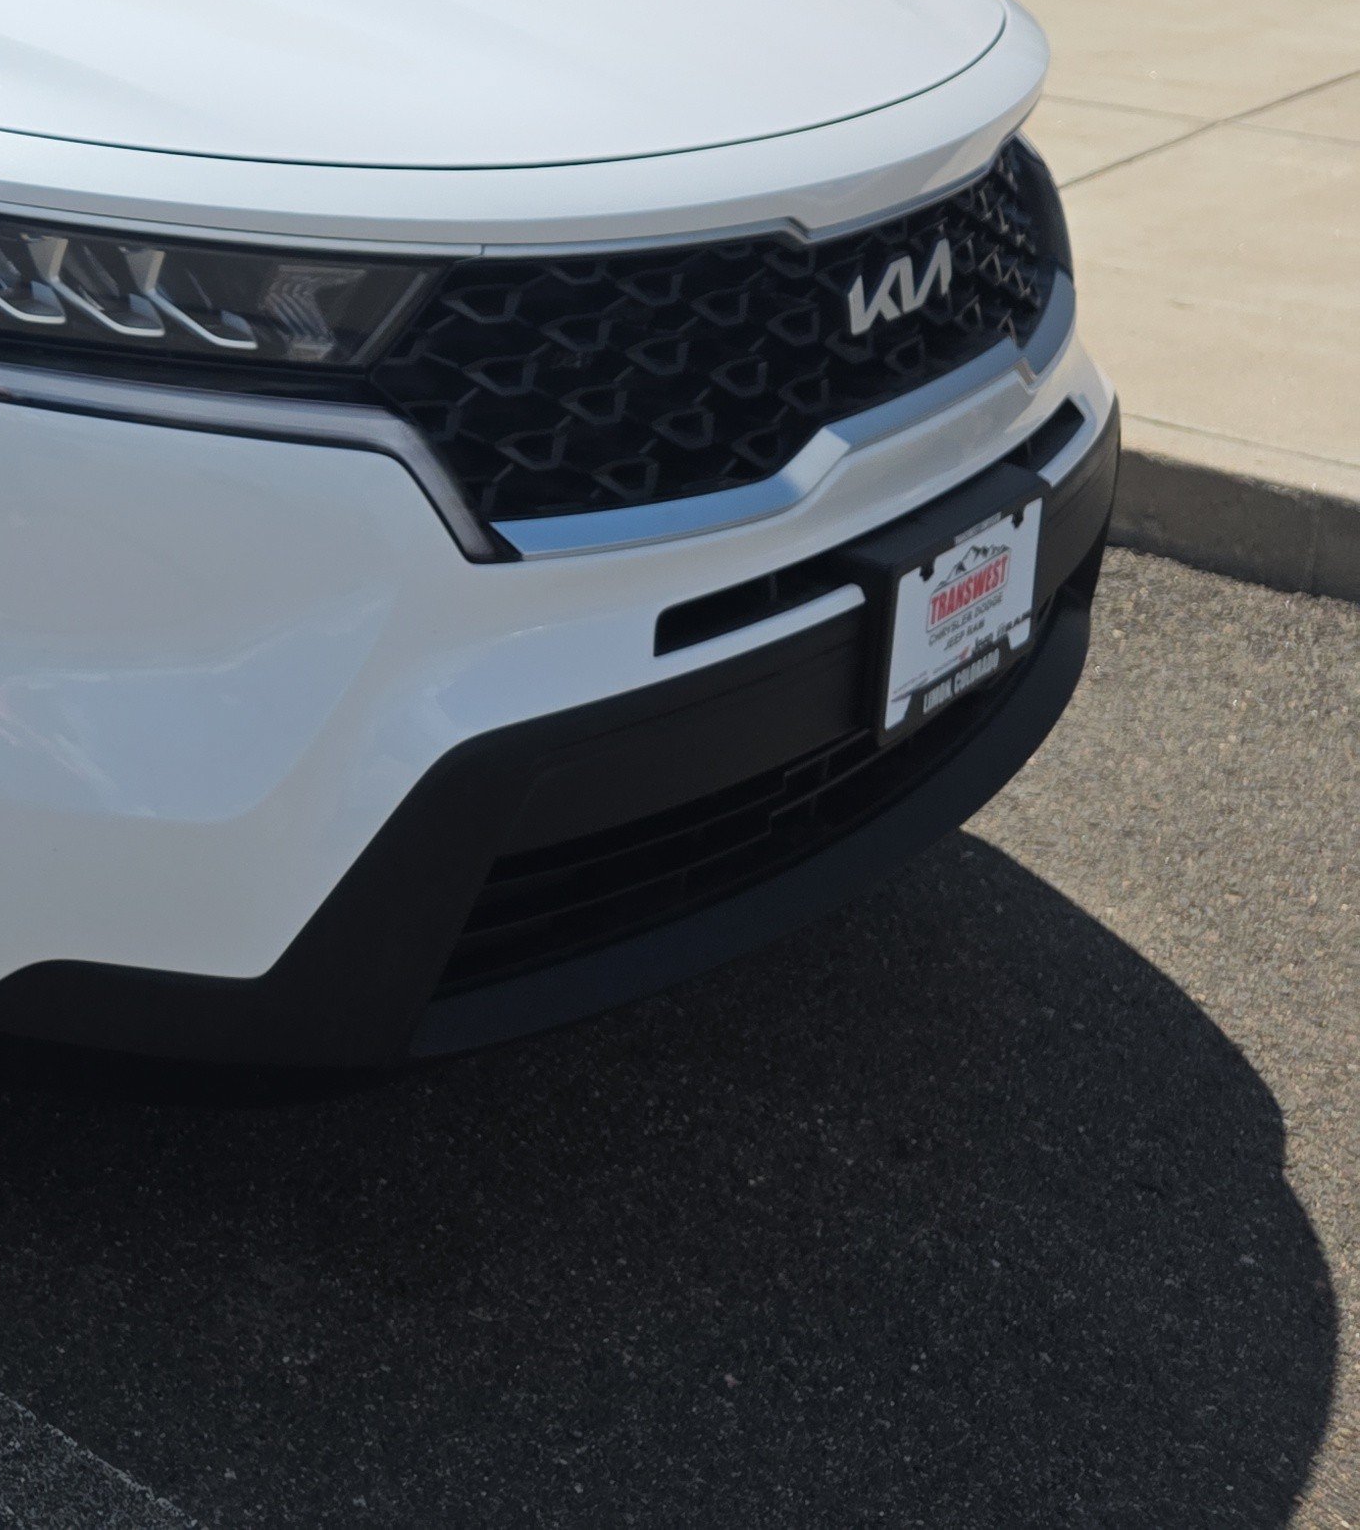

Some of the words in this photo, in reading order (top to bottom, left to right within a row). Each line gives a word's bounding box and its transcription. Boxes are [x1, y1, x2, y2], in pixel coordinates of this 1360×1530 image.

[847, 237, 953, 336] KIA
[930, 553, 1008, 626] TRANSWEST
[928, 610, 973, 647] CHRYSLER
[974, 590, 1004, 619] DODGE
[944, 629, 966, 651] JEEP
[954, 646, 1001, 695] COLORADO
